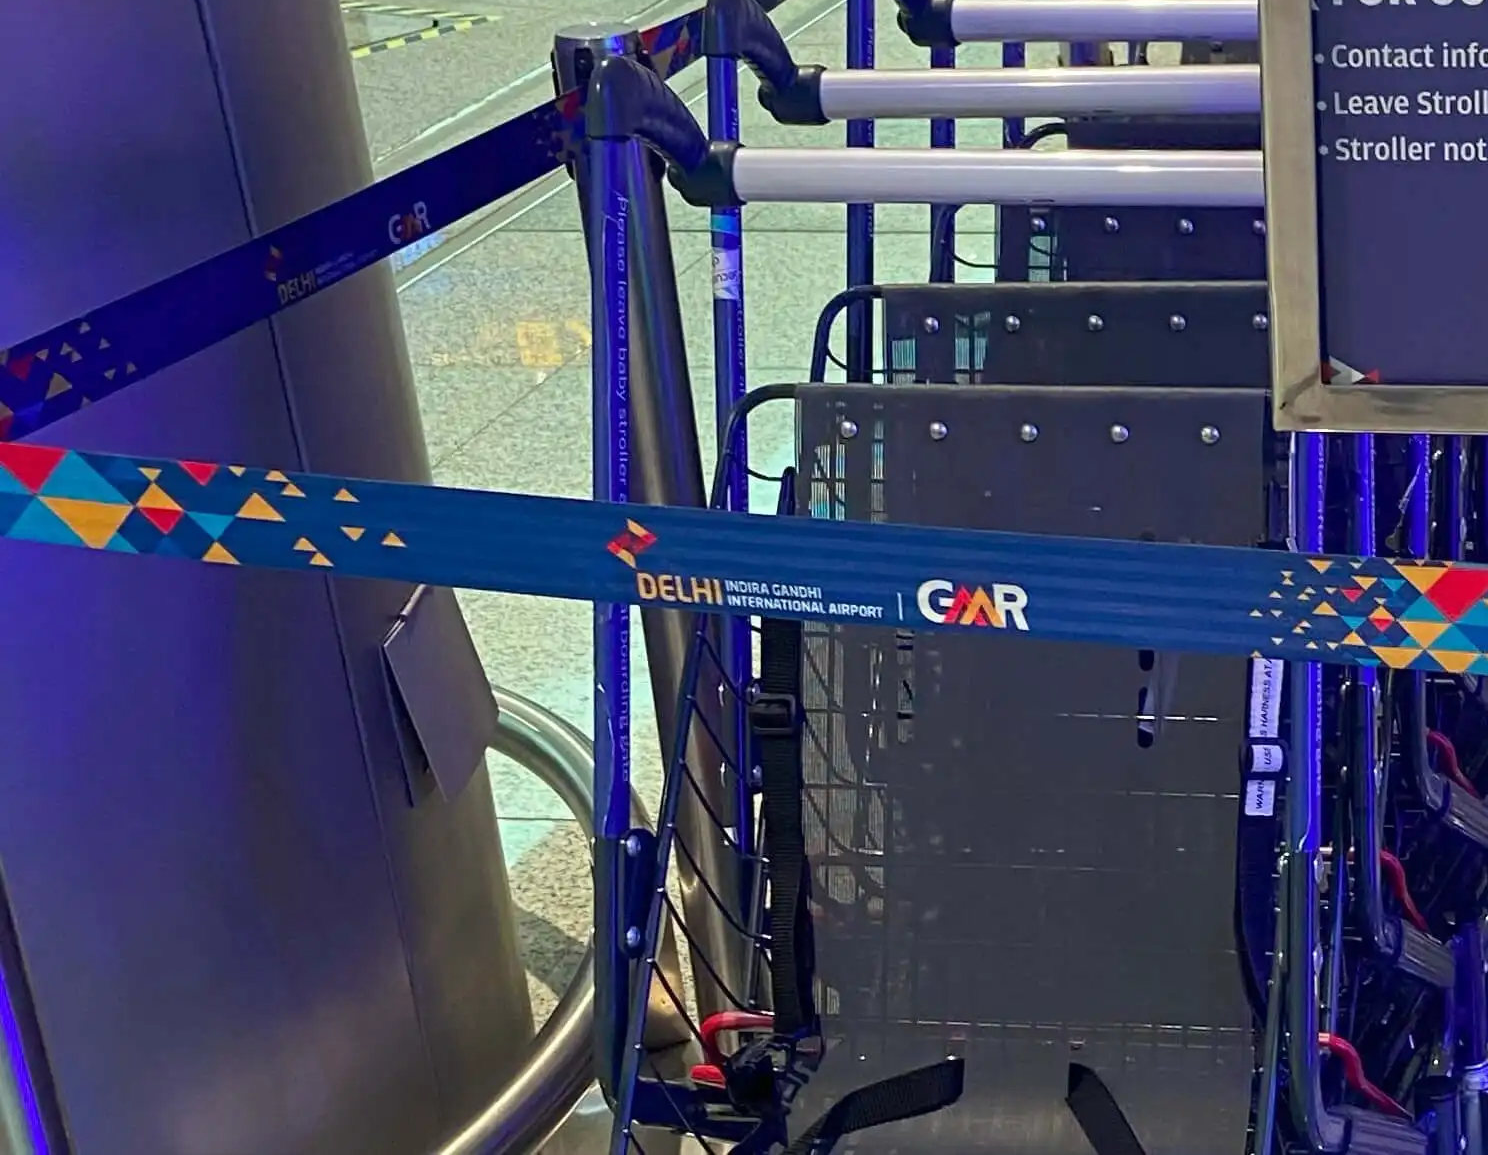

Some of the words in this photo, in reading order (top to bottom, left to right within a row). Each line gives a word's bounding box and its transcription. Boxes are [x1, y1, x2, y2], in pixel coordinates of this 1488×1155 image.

[1331, 44, 1434, 69] Contact
[1333, 91, 1409, 116] Leave
[1335, 136, 1436, 162] Stroller
[1443, 139, 1487, 162] not
[616, 195, 629, 273] Please
[277, 269, 317, 305] DELHI
[616, 280, 629, 341] leave
[615, 347, 628, 402] baby
[617, 408, 629, 486] stroller
[637, 572, 722, 605] DELHI
[724, 579, 769, 594] INDIRA
[771, 583, 822, 599] GANDHI
[726, 595, 826, 615] INTERNATIONAL
[828, 604, 884, 619] AIRPORT
[917, 579, 1030, 630] GMR
[618, 630, 630, 731] boarding
[1263, 663, 1273, 679] AT
[1259, 679, 1272, 728] HARNESS
[618, 735, 630, 783] gate
